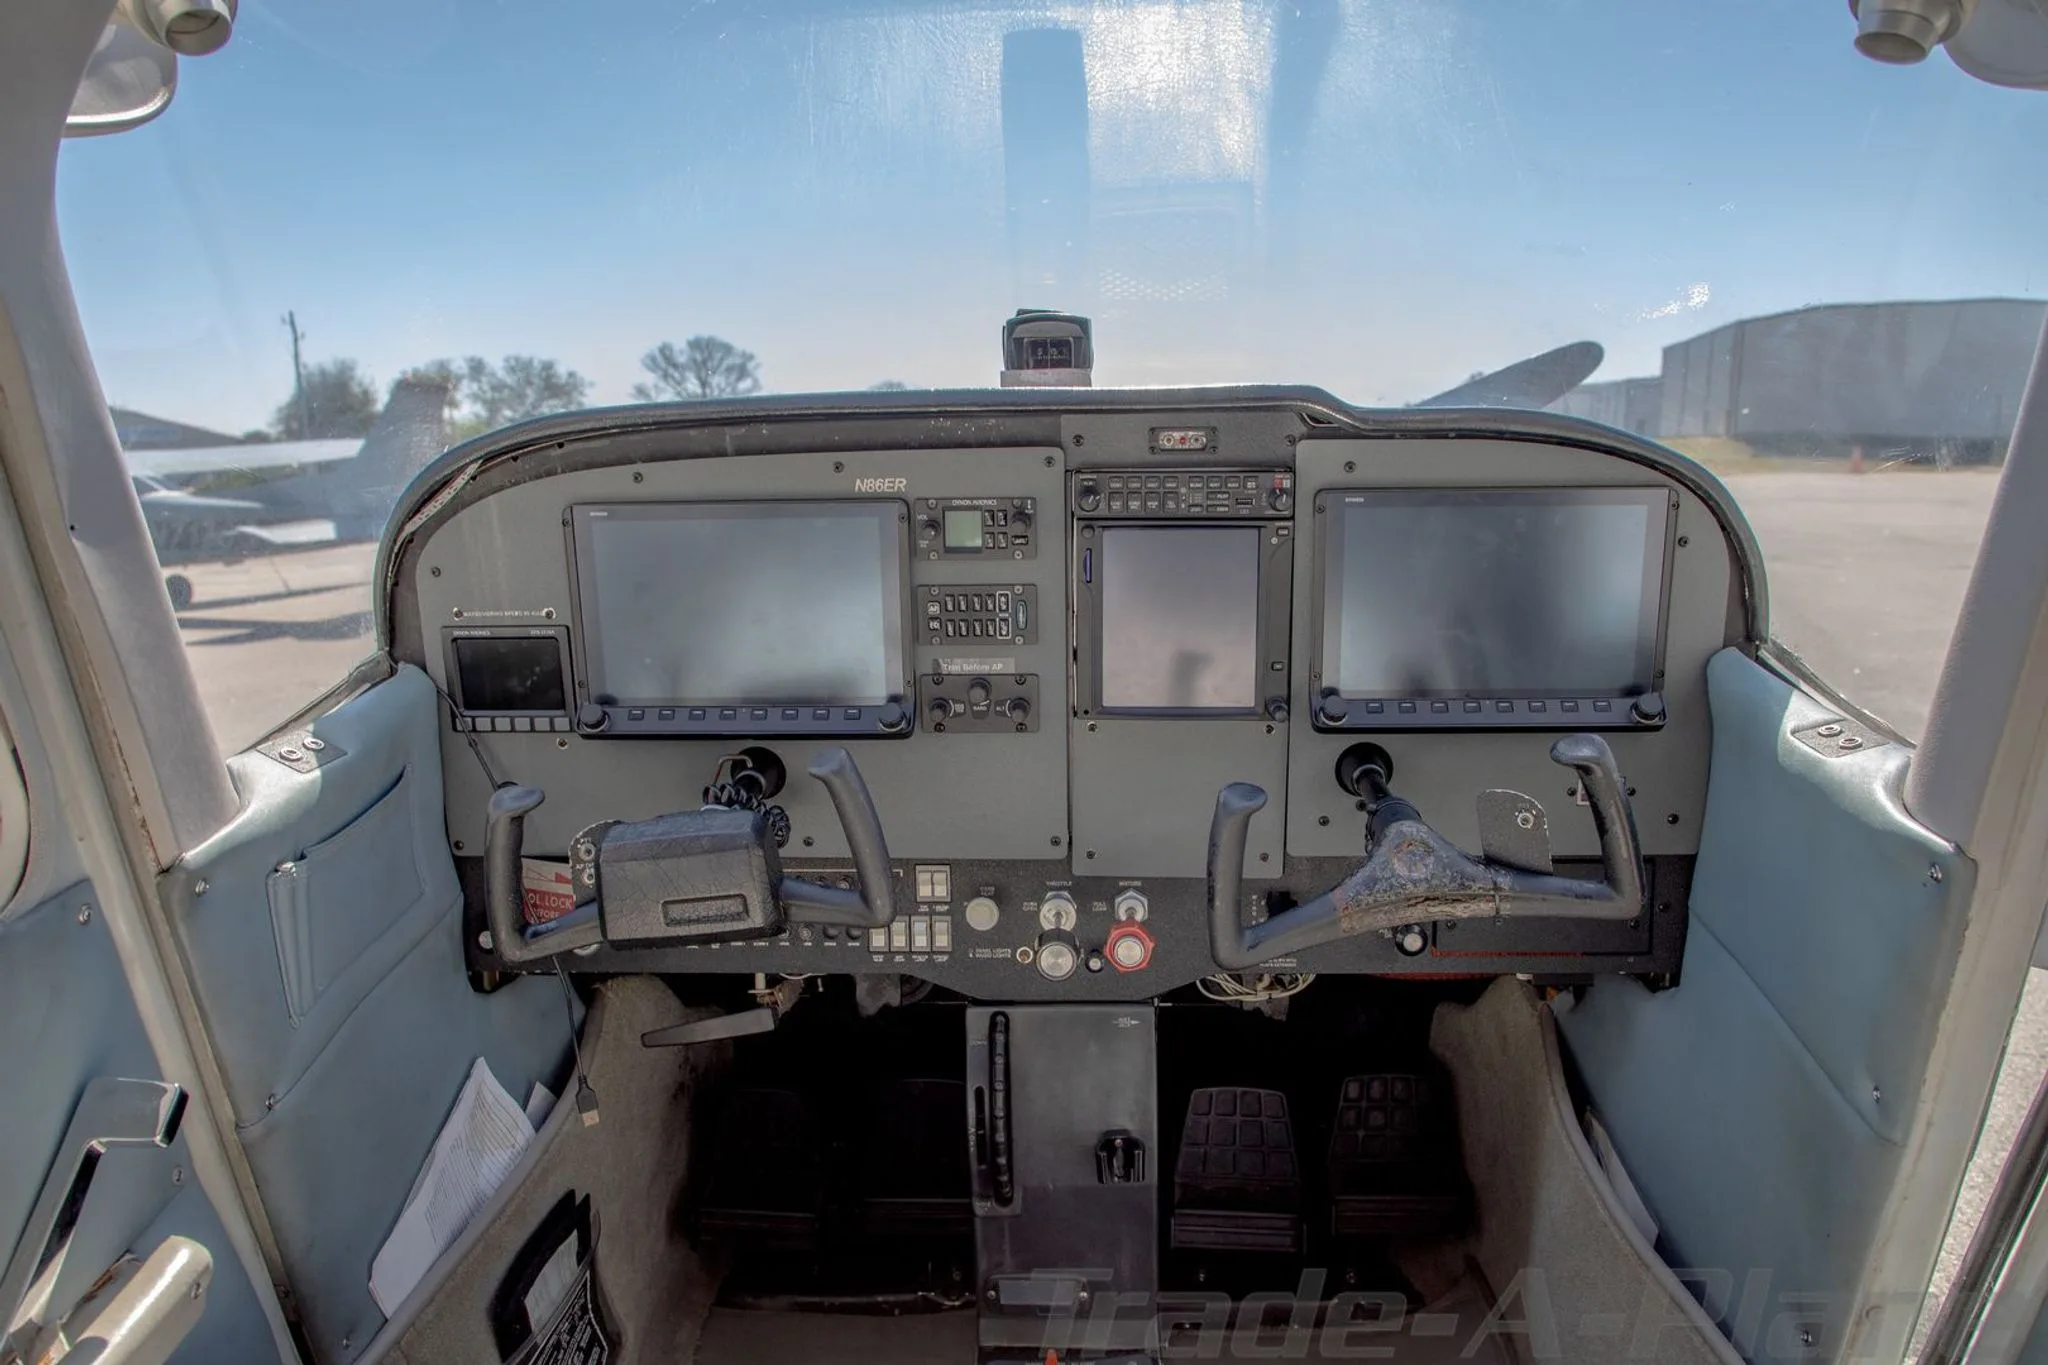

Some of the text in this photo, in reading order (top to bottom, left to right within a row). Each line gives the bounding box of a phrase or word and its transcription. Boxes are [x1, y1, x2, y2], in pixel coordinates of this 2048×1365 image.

[854, 477, 907, 493] N86ER
[963, 662, 990, 670] Before
[991, 662, 1004, 670] AP
[544, 895, 573, 910] LOCK
